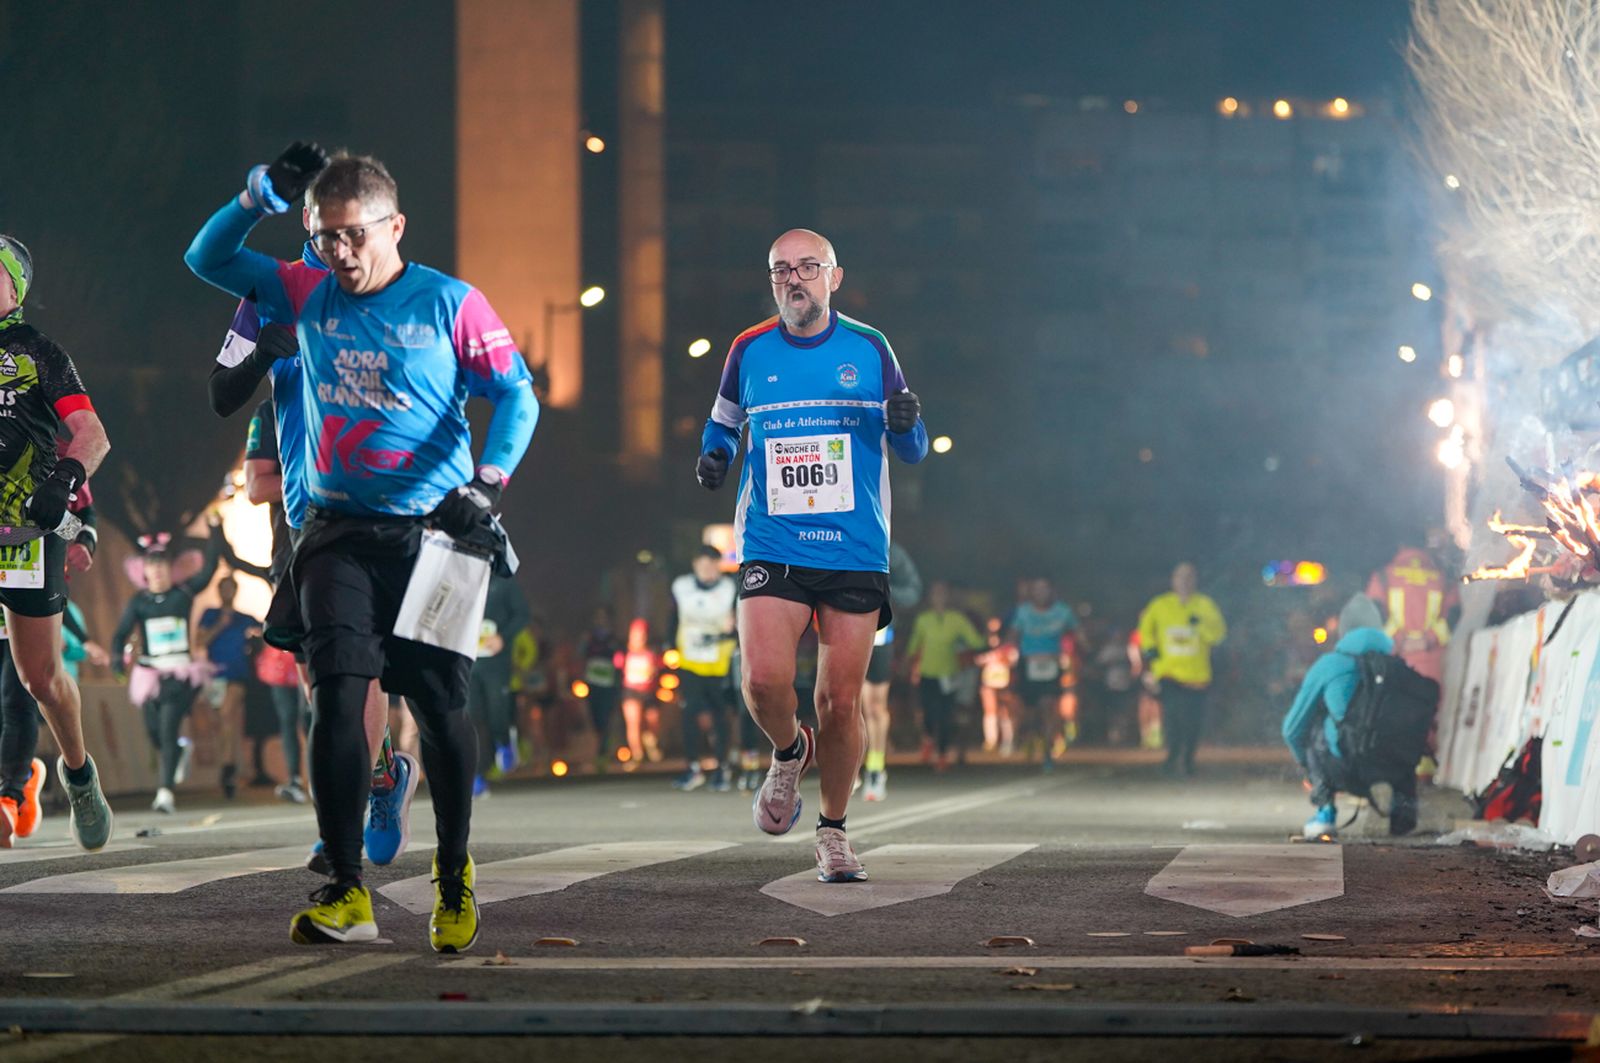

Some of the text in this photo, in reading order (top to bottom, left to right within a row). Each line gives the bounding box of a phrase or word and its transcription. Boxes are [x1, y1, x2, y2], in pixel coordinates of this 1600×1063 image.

[332, 348, 389, 370] ADRA
[762, 418, 783, 431] Club
[784, 417, 796, 428] de
[784, 445, 809, 455] NOCHE
[810, 443, 820, 452] DE
[775, 455, 791, 465] SAN
[781, 463, 838, 489] 6069
[798, 530, 843, 542] RONDA
